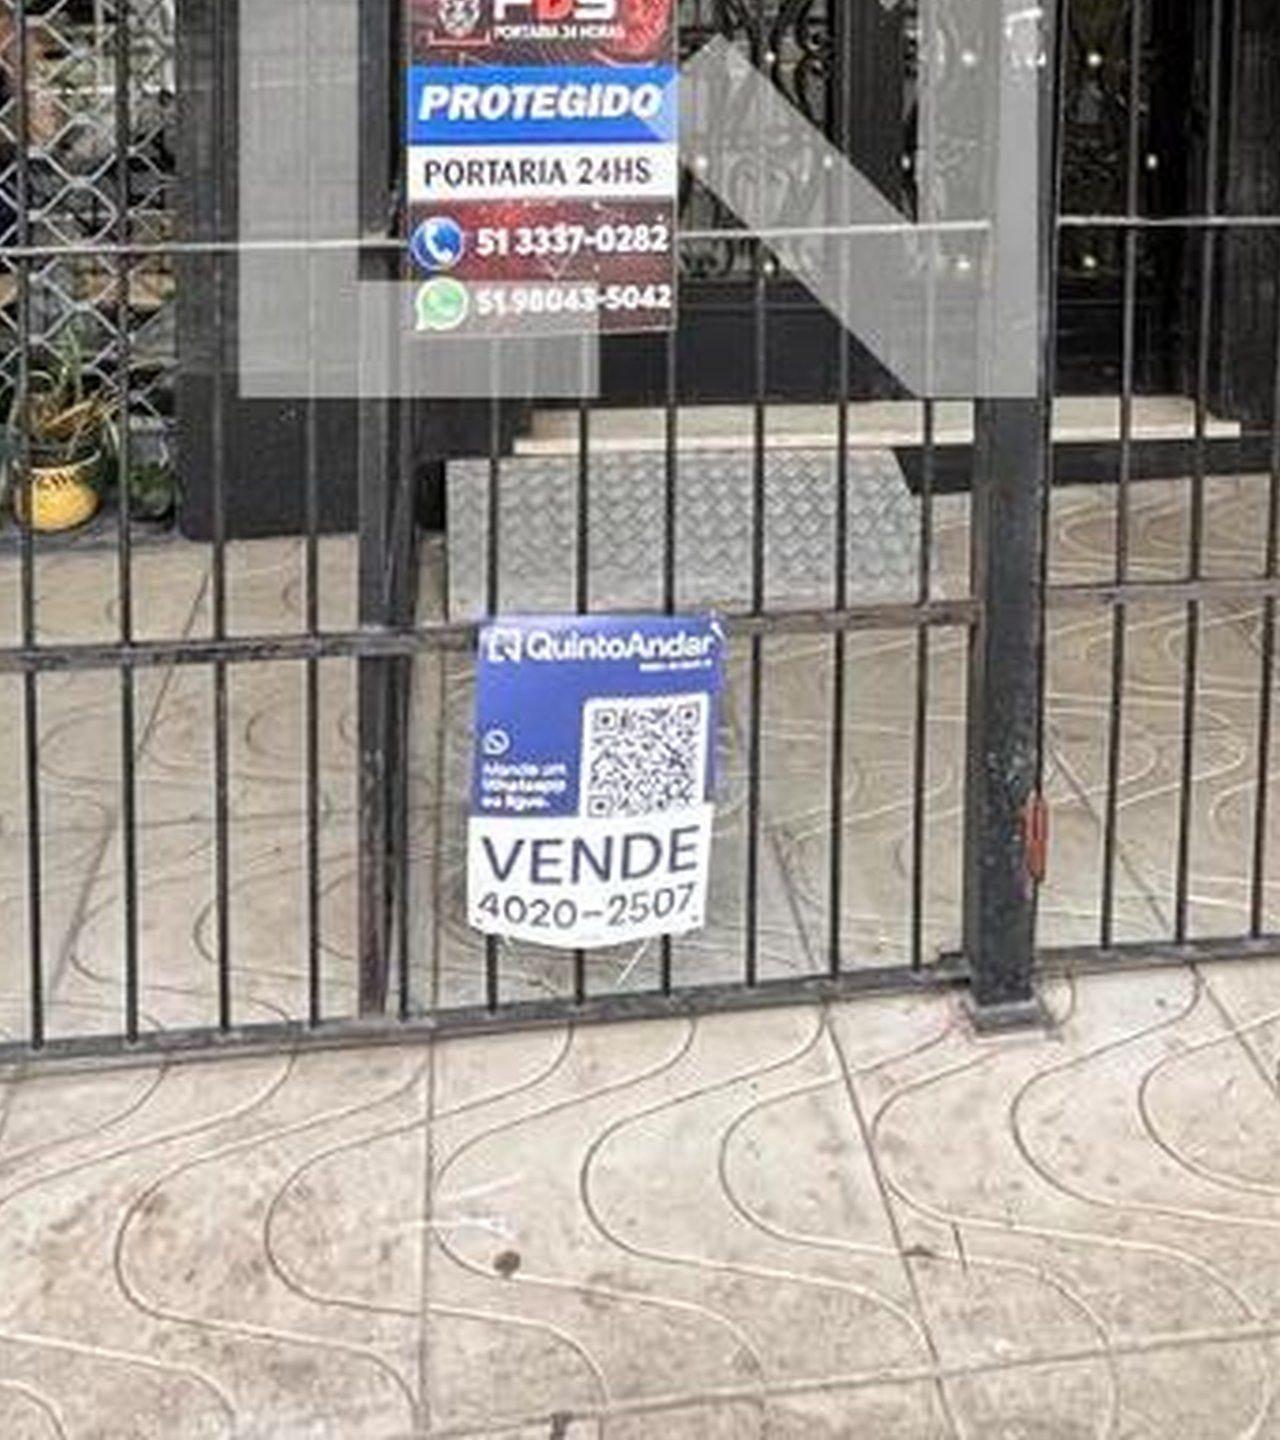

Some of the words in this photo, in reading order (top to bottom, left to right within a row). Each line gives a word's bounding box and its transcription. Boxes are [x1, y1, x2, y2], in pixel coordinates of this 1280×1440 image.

[418, 83, 662, 121] PROTEGIDO
[424, 159, 567, 187] PORTARIA
[576, 156, 652, 185] 24HS
[476, 228, 509, 256] 51
[514, 223, 669, 255] 3337-0282
[526, 629, 715, 661] QuintoAndar
[481, 824, 700, 885] VENDE
[477, 881, 698, 929] 4020-2507
